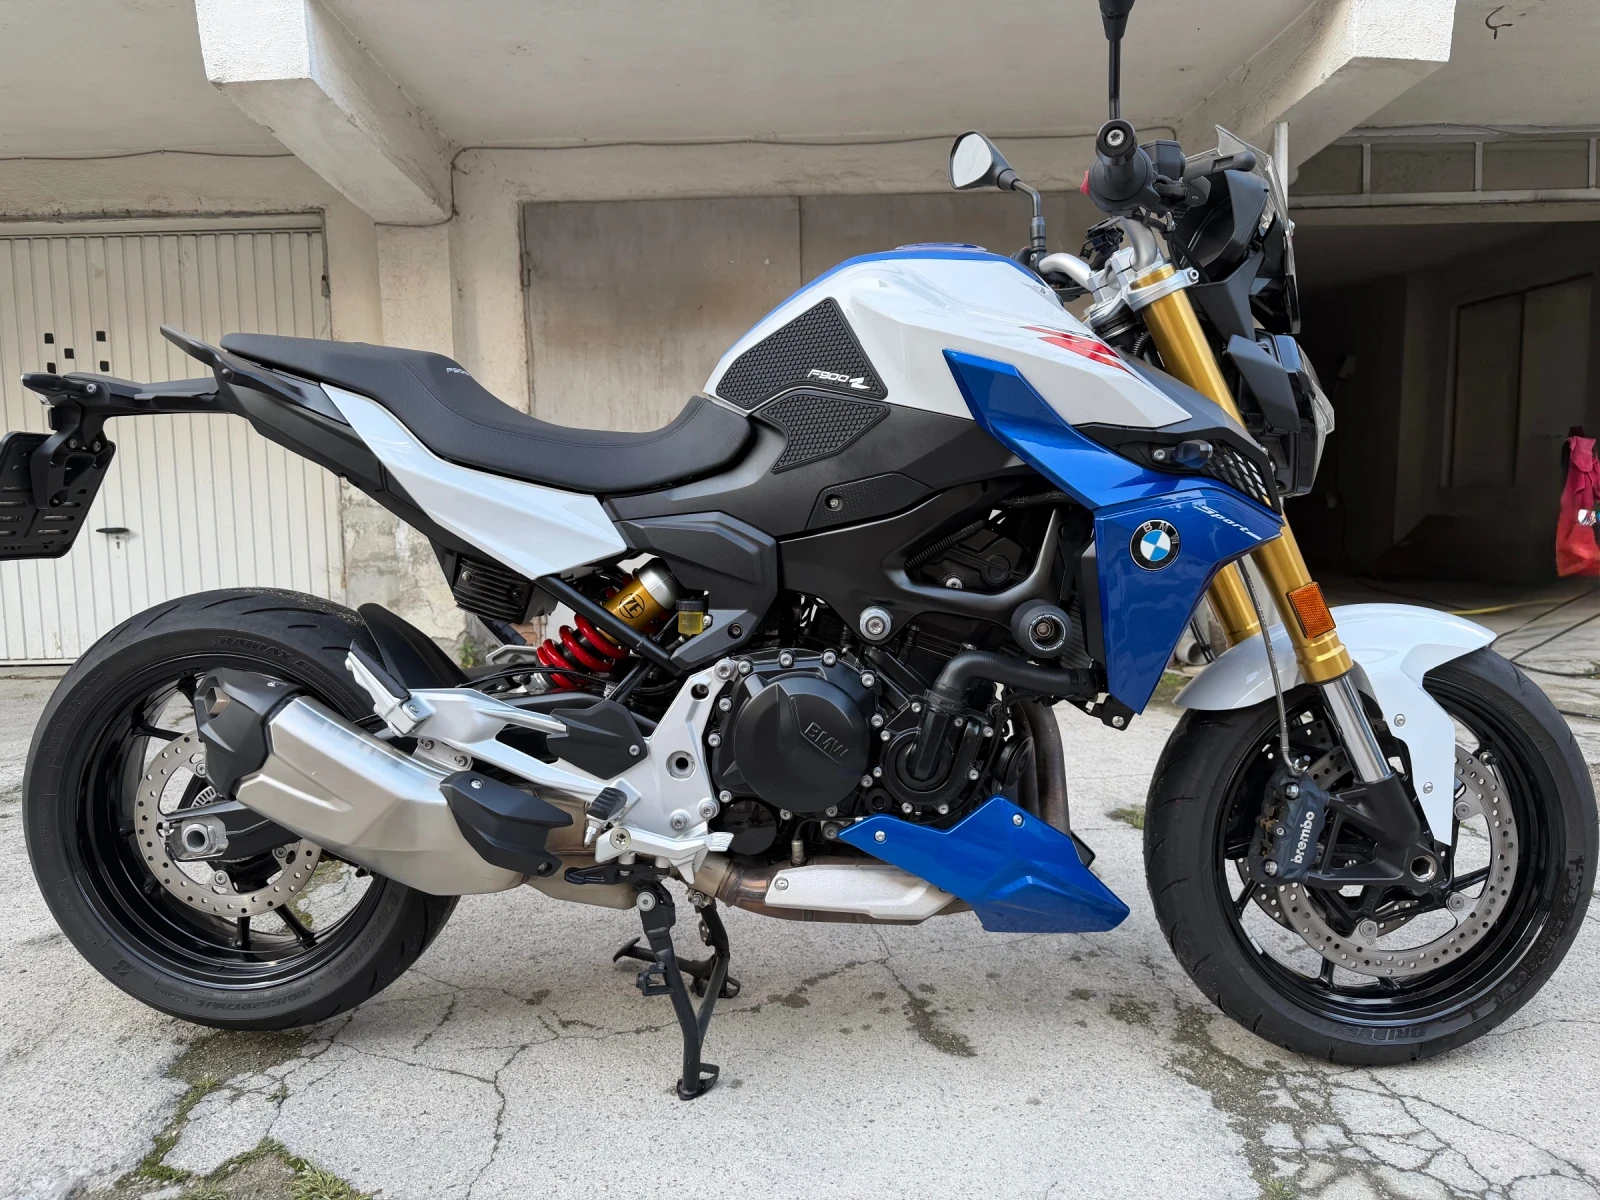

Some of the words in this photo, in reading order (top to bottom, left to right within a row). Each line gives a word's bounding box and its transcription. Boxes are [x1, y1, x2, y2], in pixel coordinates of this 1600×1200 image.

[807, 368, 850, 383] F900
[1198, 505, 1254, 534] Sport
[804, 721, 850, 759] BMW
[1290, 811, 1316, 864] brembo
